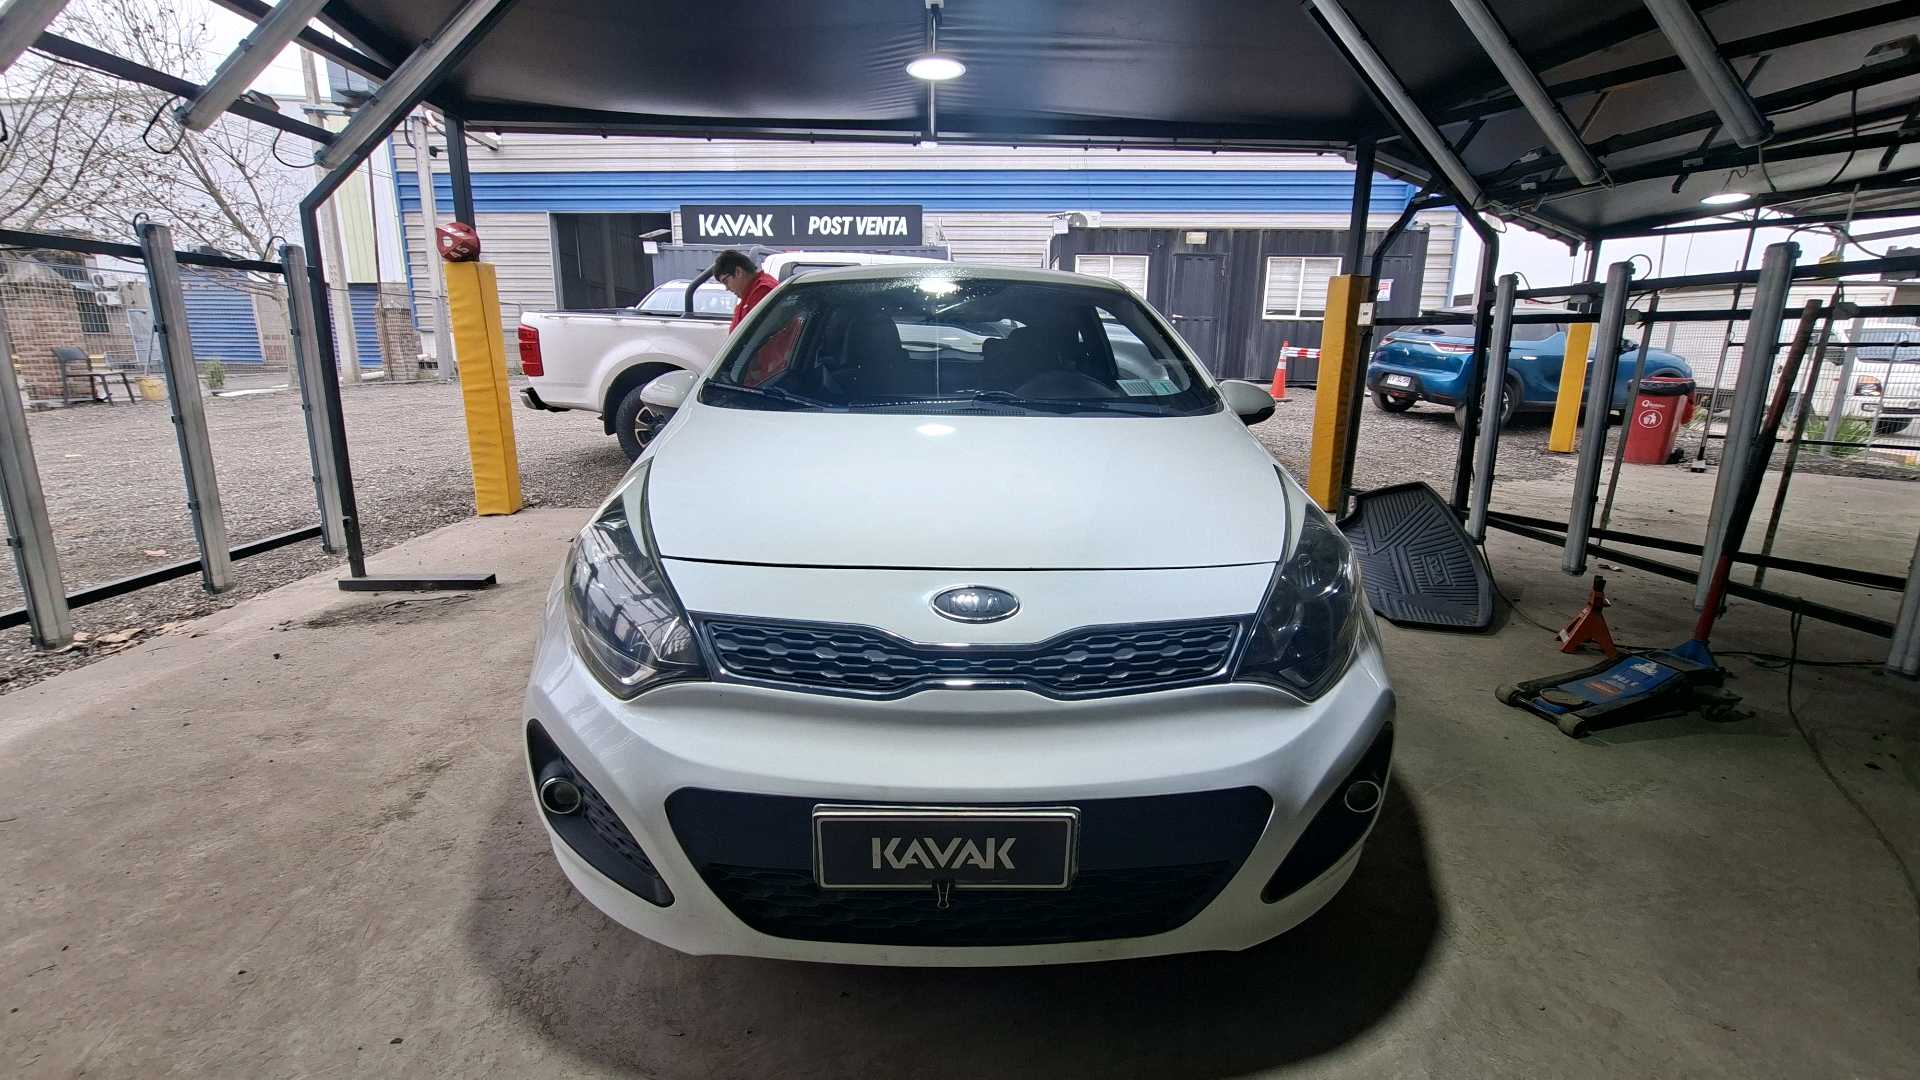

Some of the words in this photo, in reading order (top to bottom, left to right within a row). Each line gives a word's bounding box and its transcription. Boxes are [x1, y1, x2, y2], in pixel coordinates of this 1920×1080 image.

[698, 214, 774, 237] KAVAK
[808, 215, 854, 236] POST
[855, 215, 908, 236] VENTA
[871, 837, 1017, 870] KAVAK
